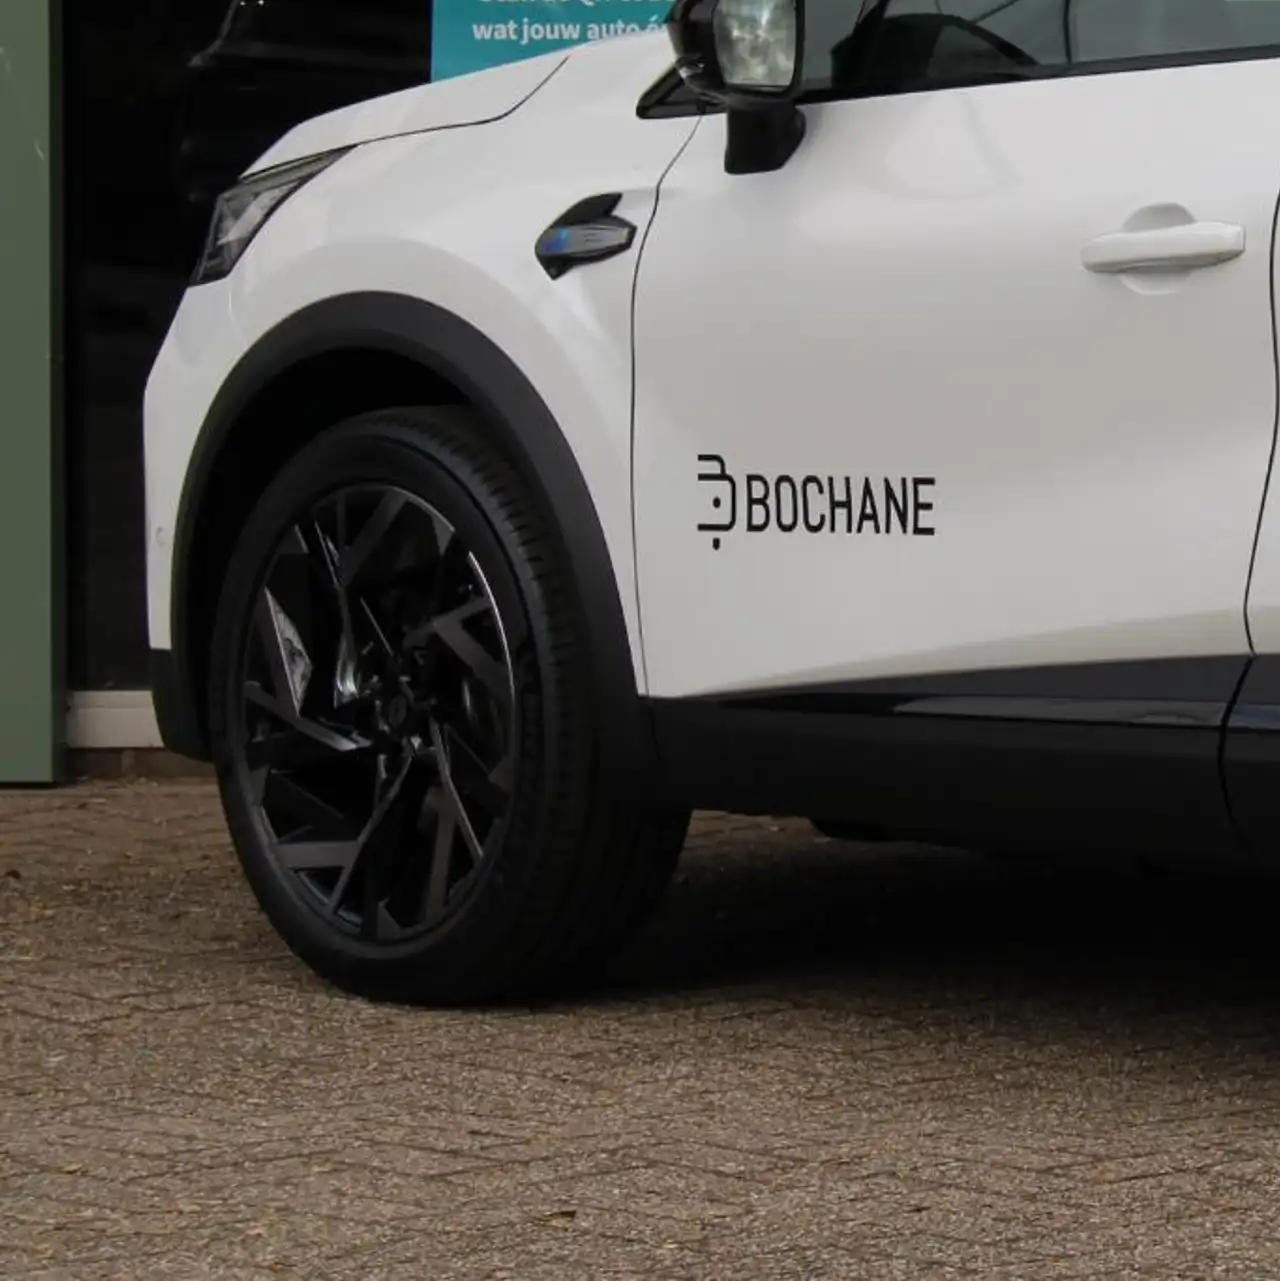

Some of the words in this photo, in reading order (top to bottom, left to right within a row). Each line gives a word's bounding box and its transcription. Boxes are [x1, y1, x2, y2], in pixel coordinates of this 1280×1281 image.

[472, 19, 518, 40] wat
[519, 17, 580, 45] jouw
[746, 474, 936, 536] BOCHANE
